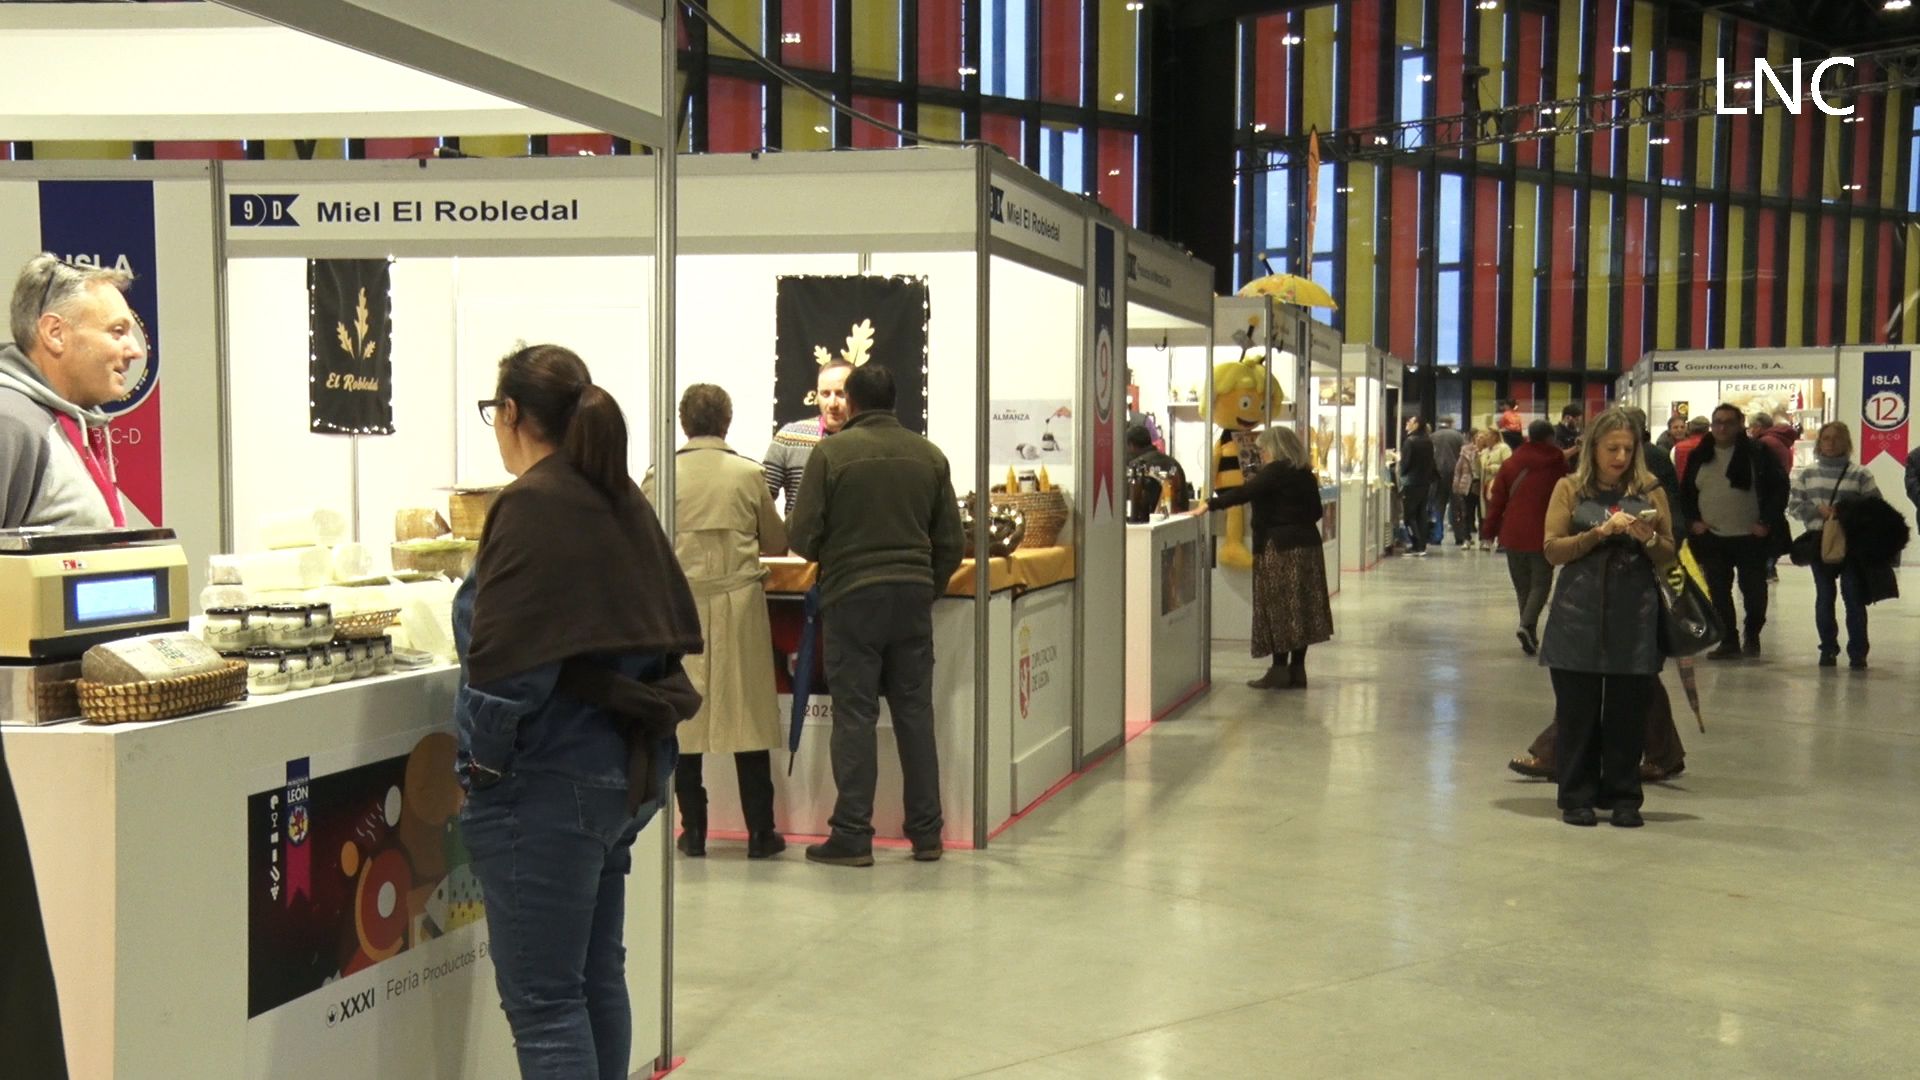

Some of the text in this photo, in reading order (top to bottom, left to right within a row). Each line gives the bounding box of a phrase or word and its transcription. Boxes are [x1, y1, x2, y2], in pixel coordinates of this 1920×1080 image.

[243, 200, 282, 220] 9 D
[317, 199, 578, 223] Miel El Robledal
[325, 372, 341, 389] El
[1872, 375, 1901, 385] ISLA
[993, 413, 1030, 421] ALMANZA
[1872, 396, 1898, 421] 12
[287, 784, 309, 804] LEÓN
[339, 988, 375, 1022] XXXI
[386, 970, 419, 1001] Feria
[423, 948, 476, 983] Productos
